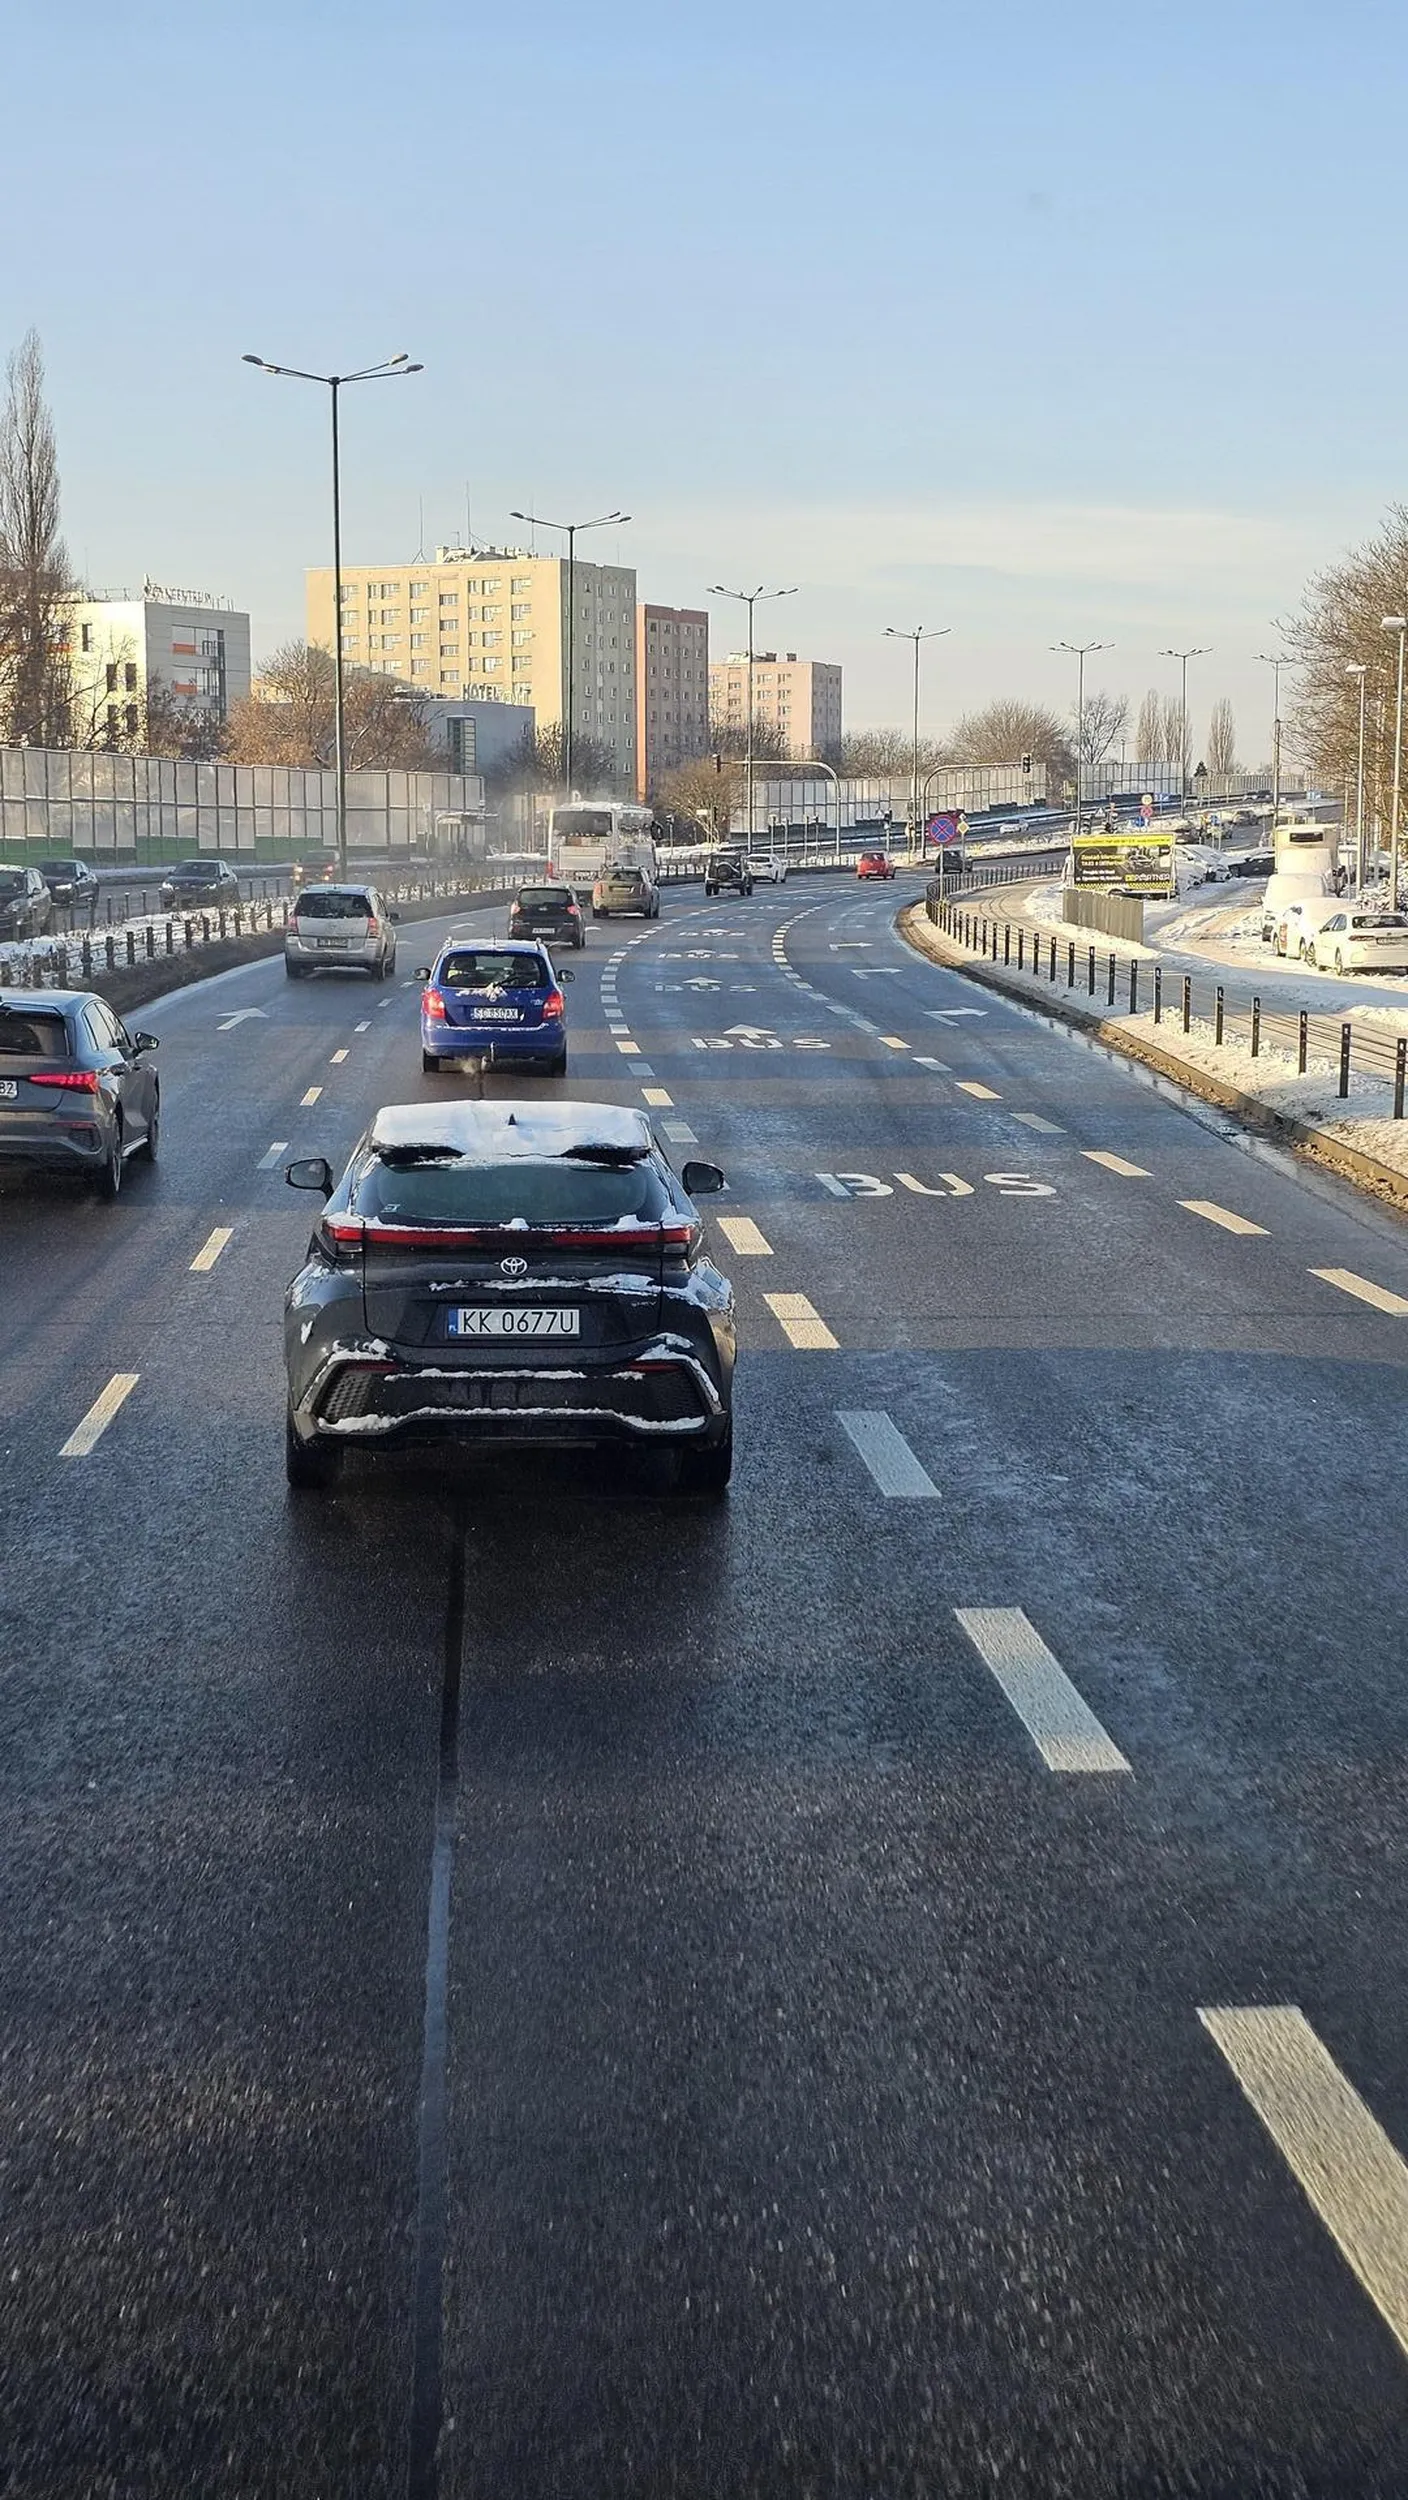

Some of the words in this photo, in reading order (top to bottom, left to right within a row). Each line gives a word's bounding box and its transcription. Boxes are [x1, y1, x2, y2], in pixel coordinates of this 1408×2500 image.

[462, 683, 499, 702] HOTEL
[691, 1038, 831, 1049] BUS
[814, 1173, 1057, 1196] BUS
[463, 1311, 492, 1333] KK
[502, 1311, 574, 1333] 0677U
